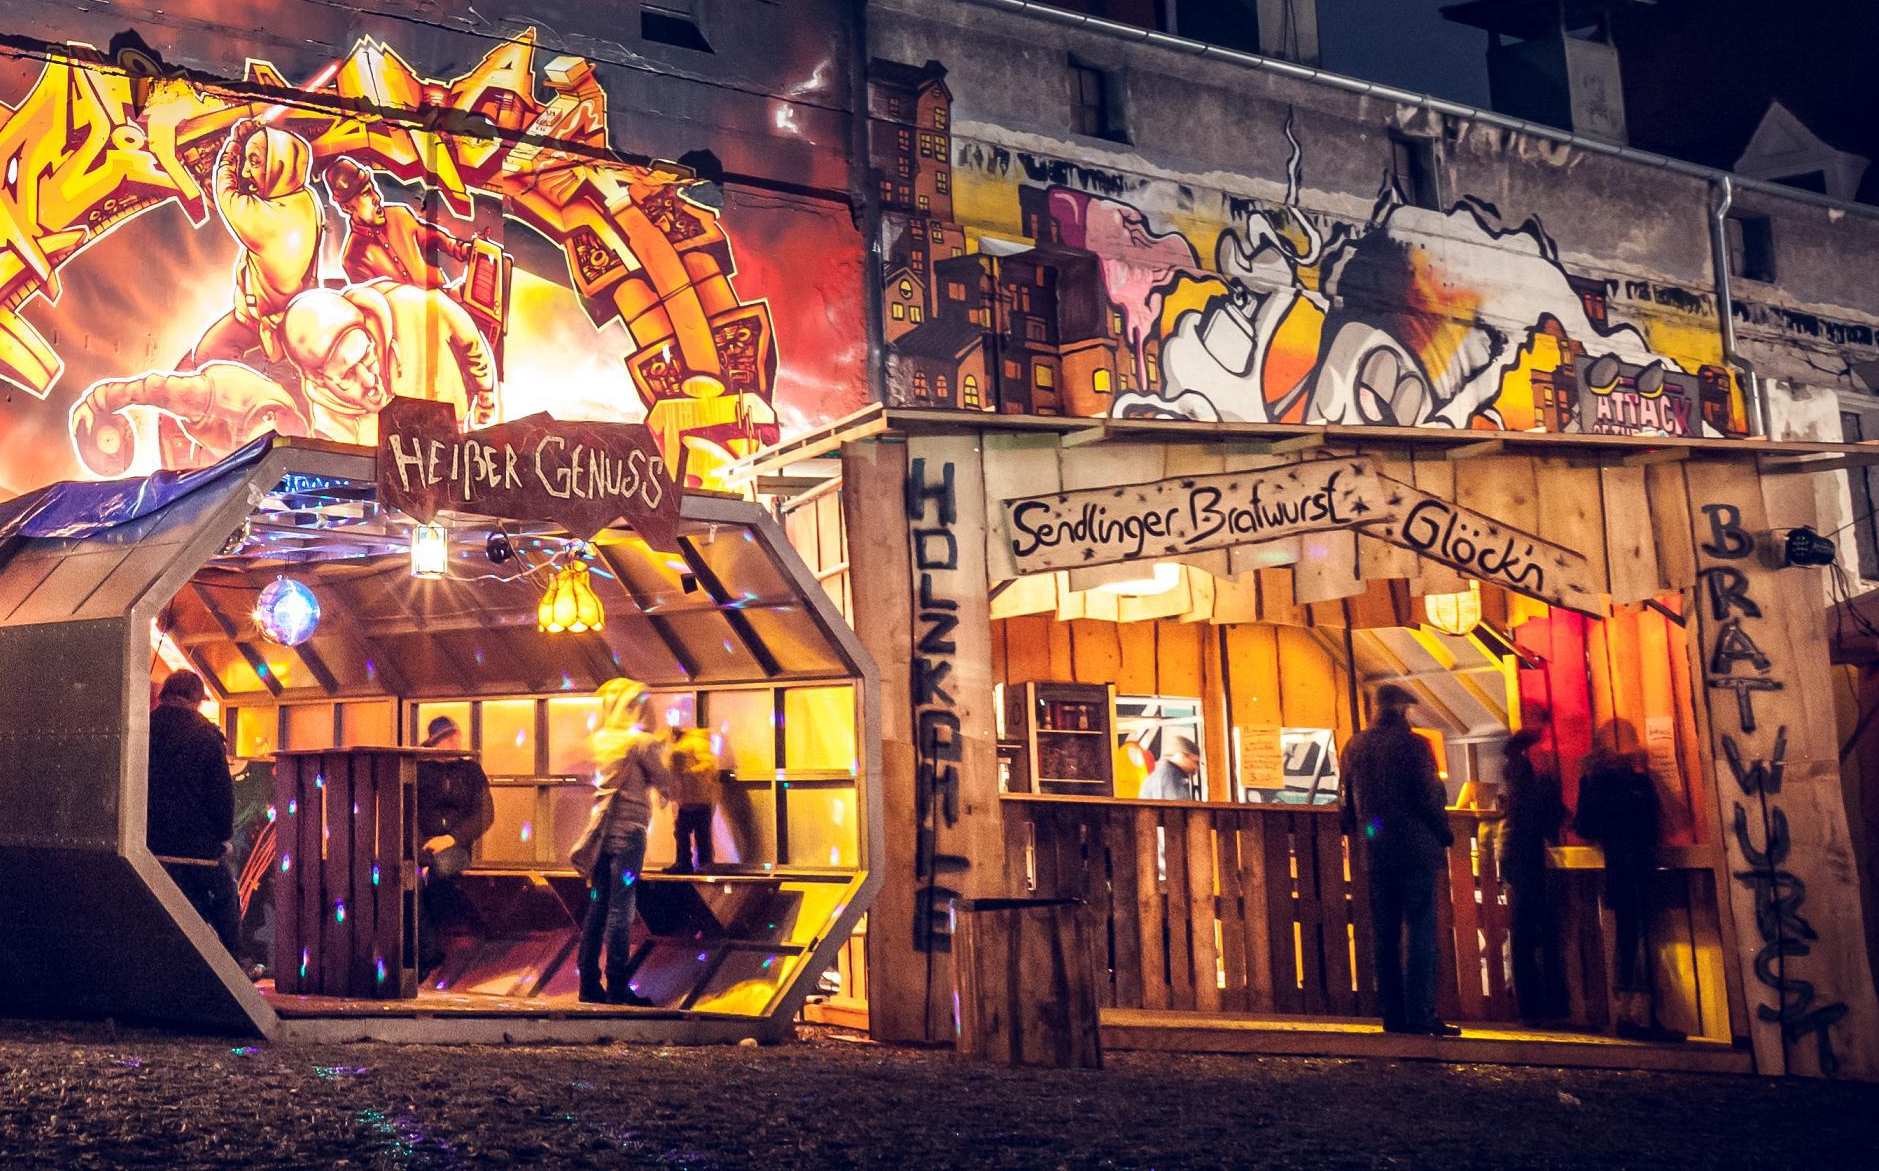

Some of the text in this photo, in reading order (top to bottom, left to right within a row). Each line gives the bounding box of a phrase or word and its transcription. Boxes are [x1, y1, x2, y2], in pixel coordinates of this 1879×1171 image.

[1596, 391, 1696, 437] ATTACK
[534, 435, 665, 509] GENUSS
[1012, 500, 1180, 559] Sendlinger
[1184, 469, 1352, 545] Bratwurst
[906, 456, 972, 954] HOLZKOHLE
[1697, 503, 1849, 1077] BRATWURST
